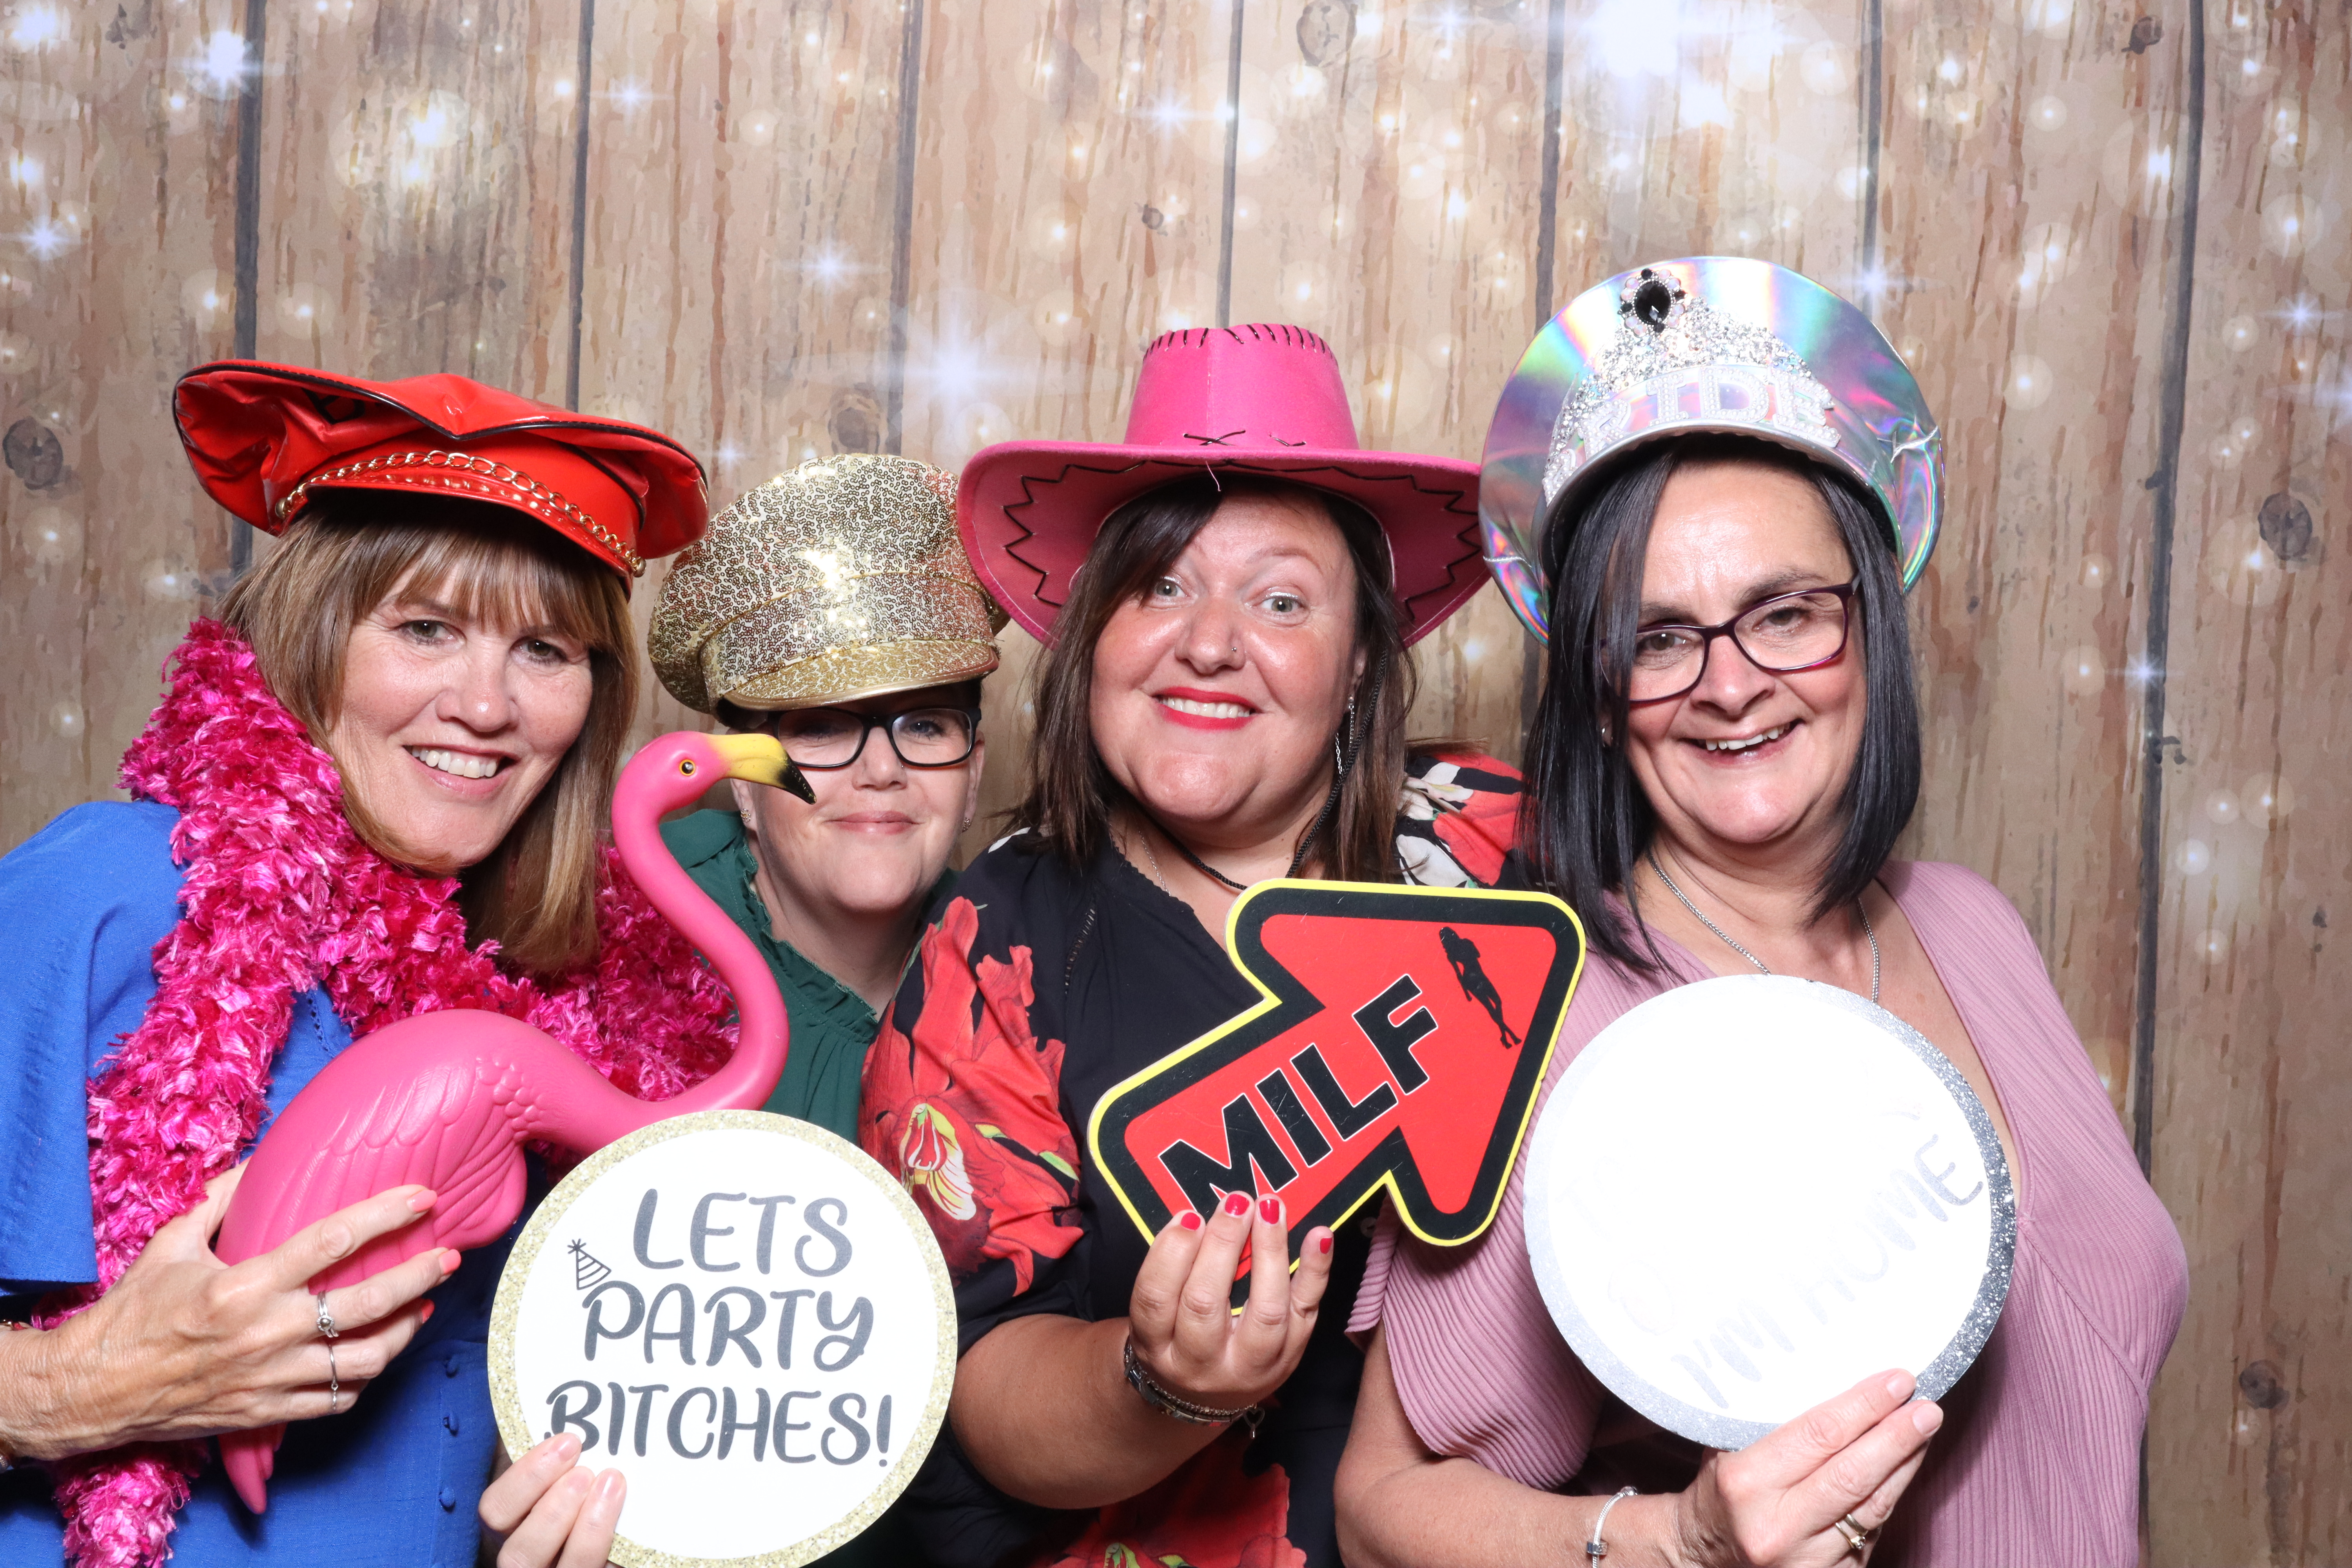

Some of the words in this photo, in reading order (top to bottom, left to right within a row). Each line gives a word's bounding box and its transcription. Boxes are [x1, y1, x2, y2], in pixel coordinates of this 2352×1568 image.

[1157, 973, 1439, 1213] MILF
[633, 1188, 853, 1278] LETS
[581, 1280, 874, 1373] PARTY
[543, 1379, 892, 1467] BITCHES!
